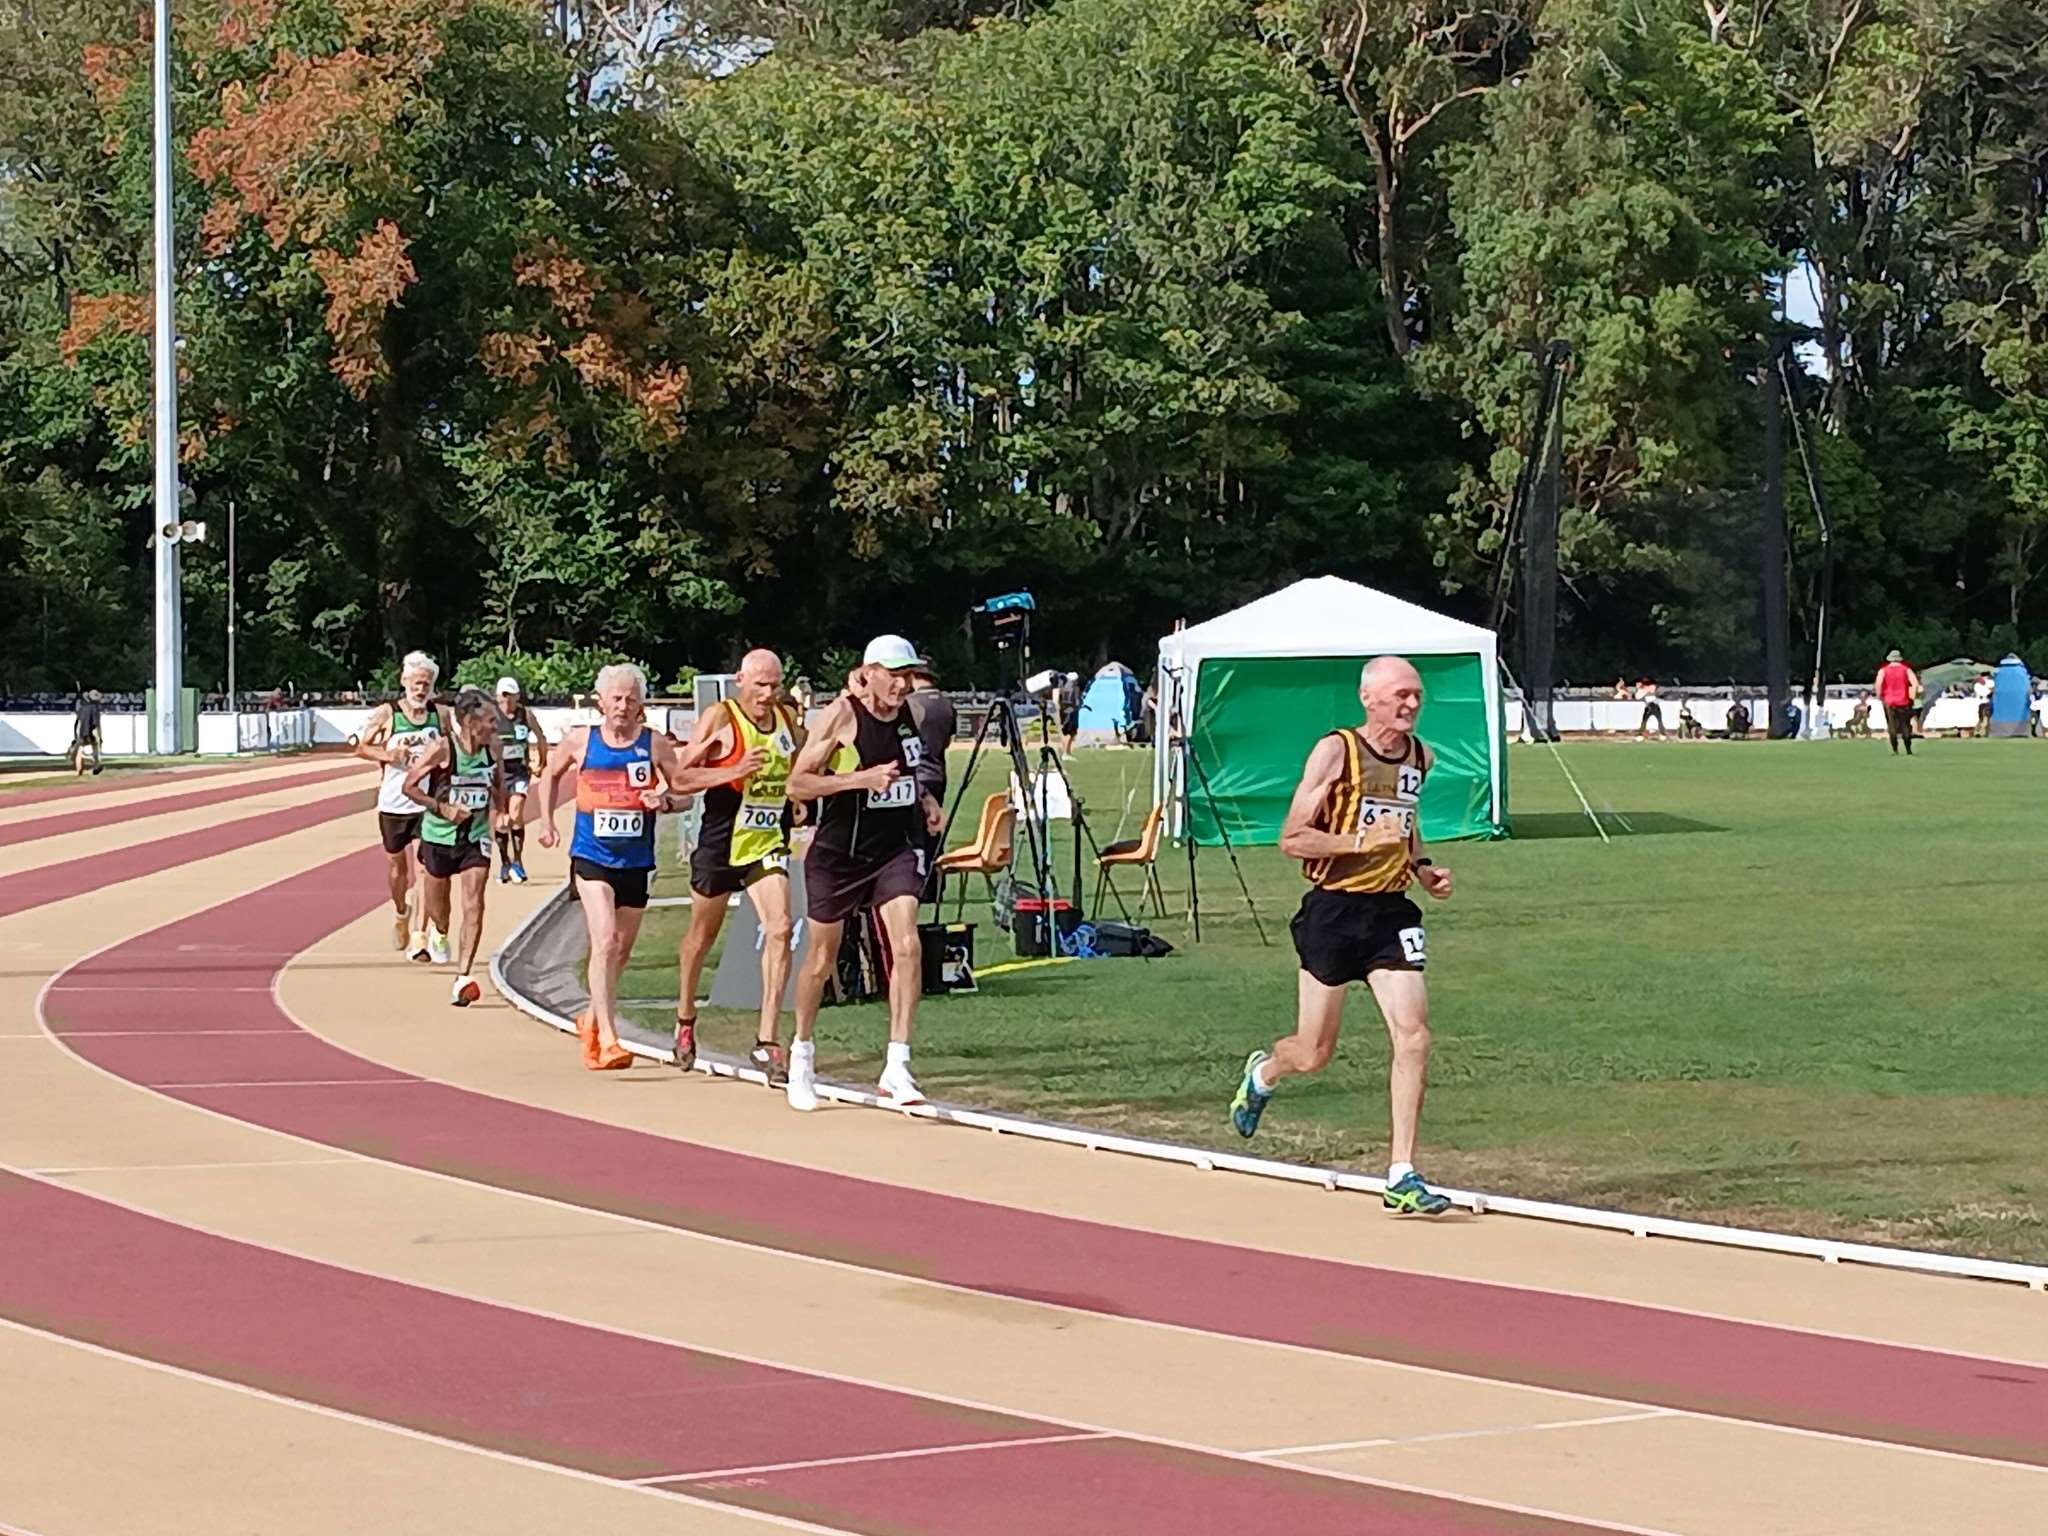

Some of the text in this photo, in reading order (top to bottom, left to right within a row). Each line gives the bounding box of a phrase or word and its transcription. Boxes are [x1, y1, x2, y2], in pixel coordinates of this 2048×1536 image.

[635, 766, 647, 782] 6
[1401, 773, 1420, 796] 12
[599, 816, 641, 832] 7010
